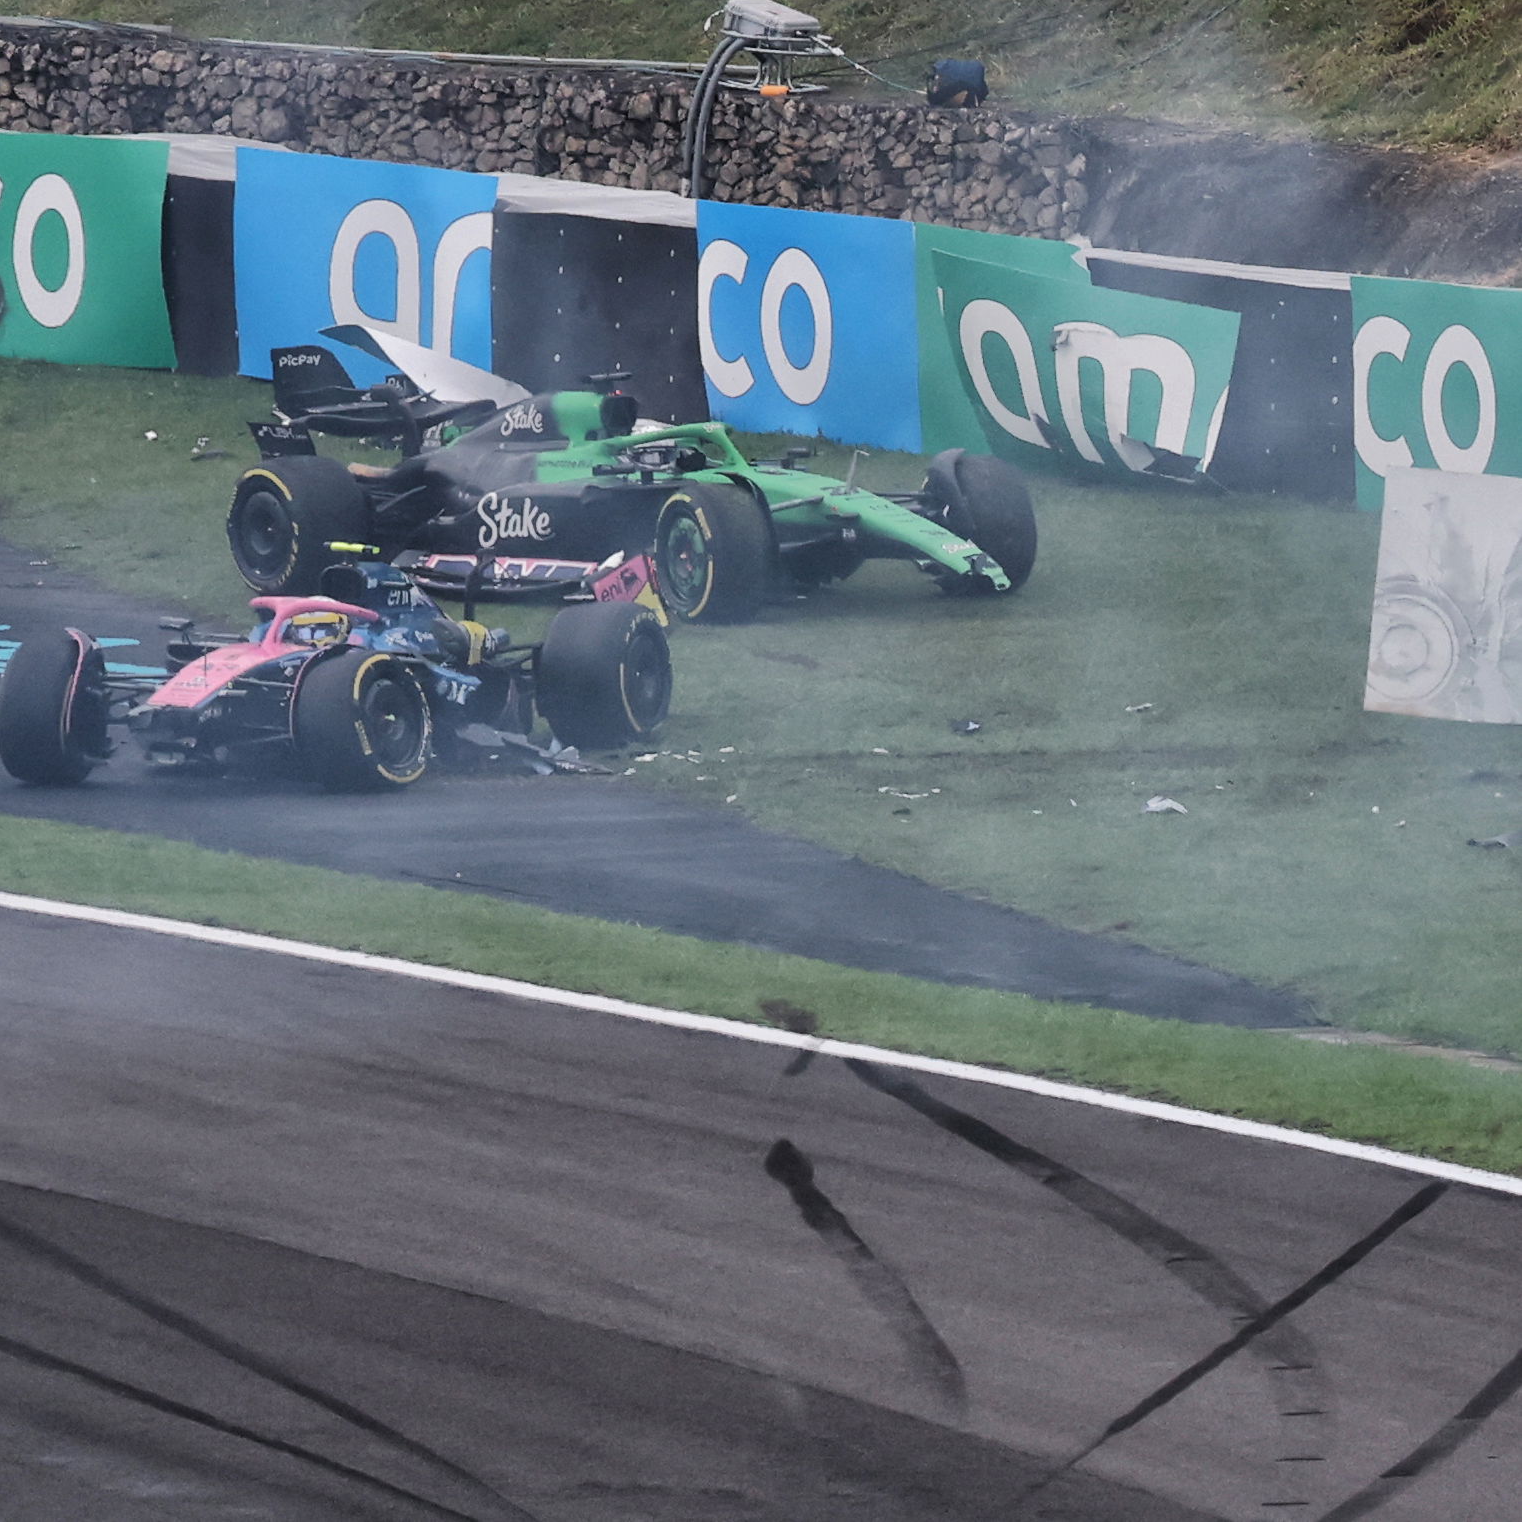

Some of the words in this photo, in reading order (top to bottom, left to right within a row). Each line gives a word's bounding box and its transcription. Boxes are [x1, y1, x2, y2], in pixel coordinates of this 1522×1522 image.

[279, 354, 322, 367] PicPay
[501, 404, 543, 436] Stake
[478, 491, 554, 548] Stake
